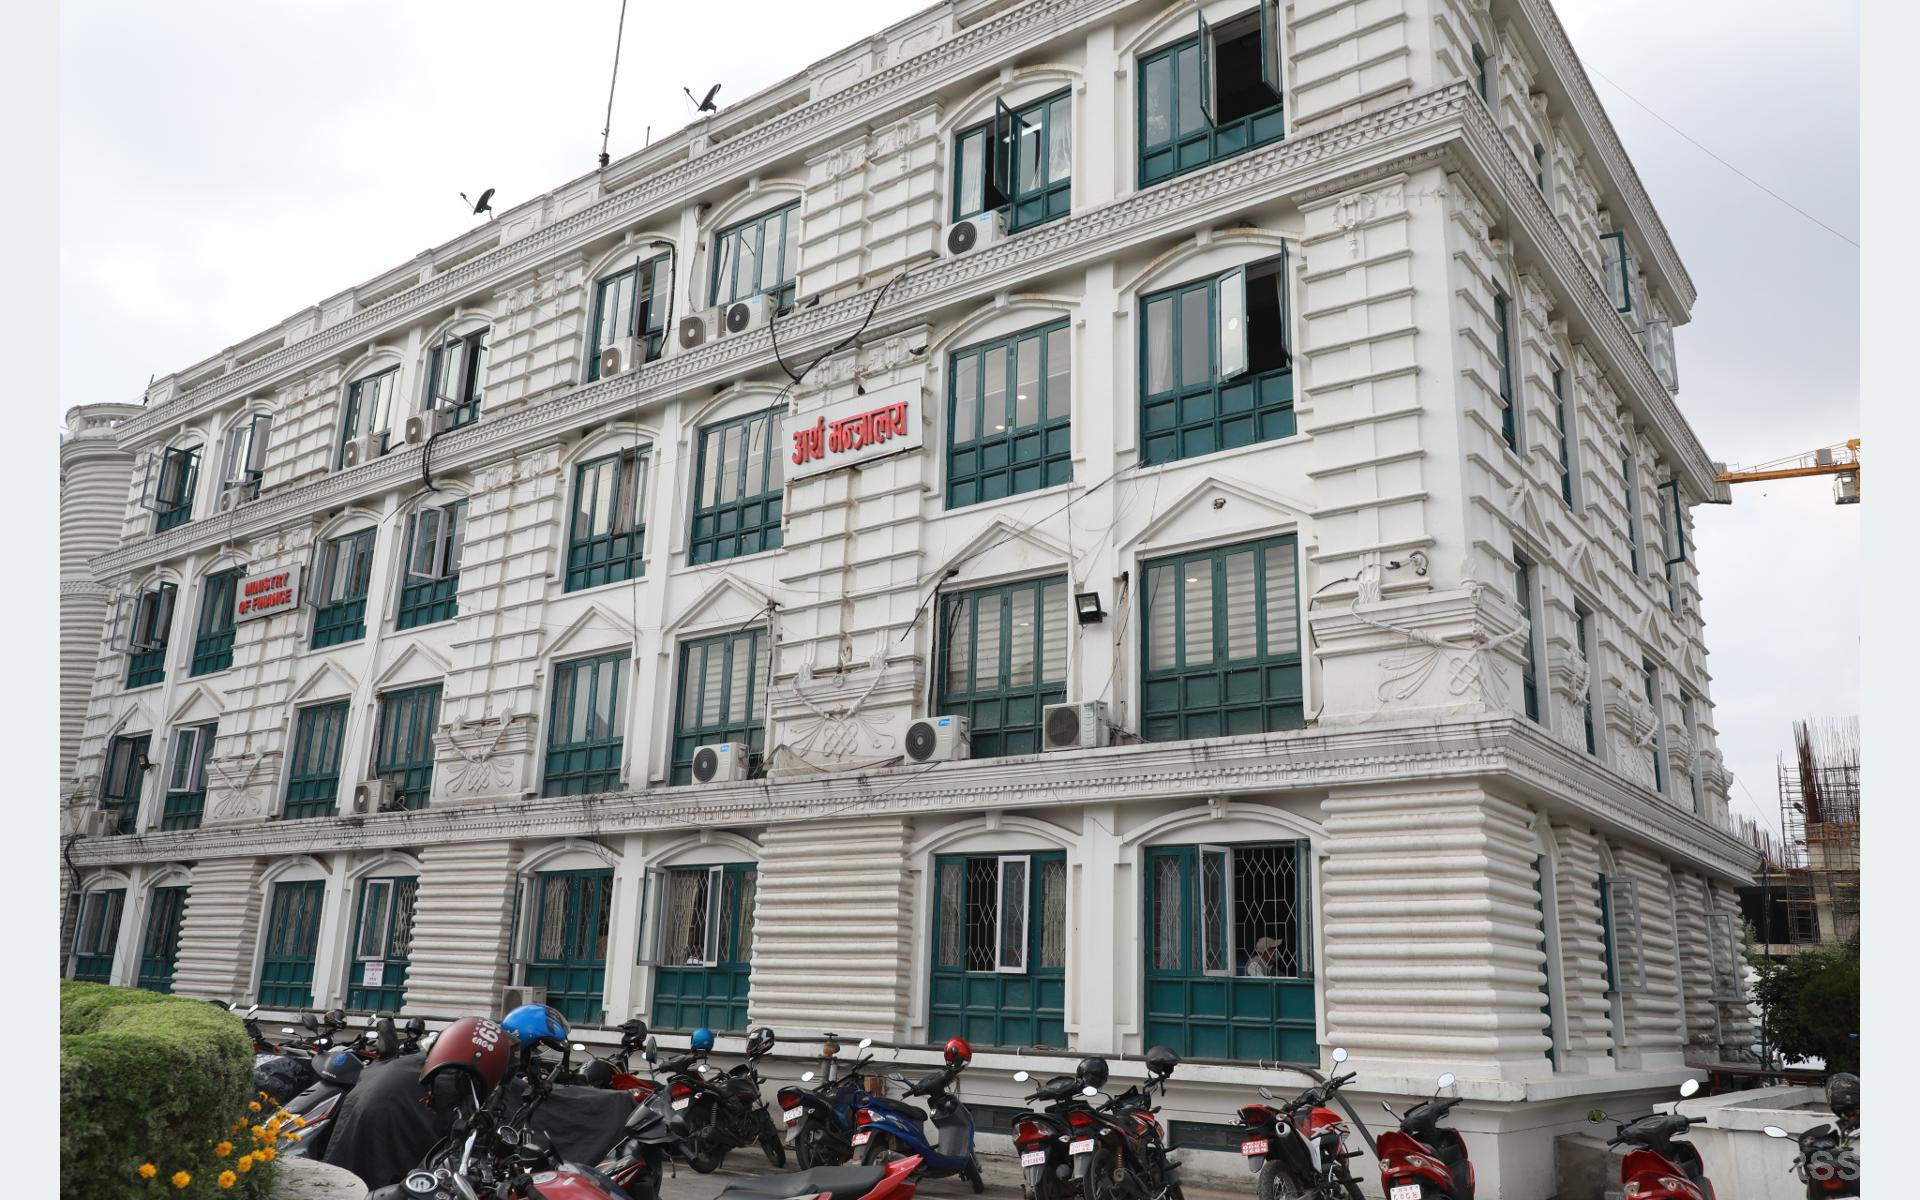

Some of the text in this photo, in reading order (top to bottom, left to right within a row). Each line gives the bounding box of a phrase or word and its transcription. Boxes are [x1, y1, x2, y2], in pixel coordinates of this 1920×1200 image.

[792, 401, 908, 464] अर्थ मन्त्रालय
[245, 572, 290, 597] MINISTRY
[239, 588, 293, 615] OF FINANCE
